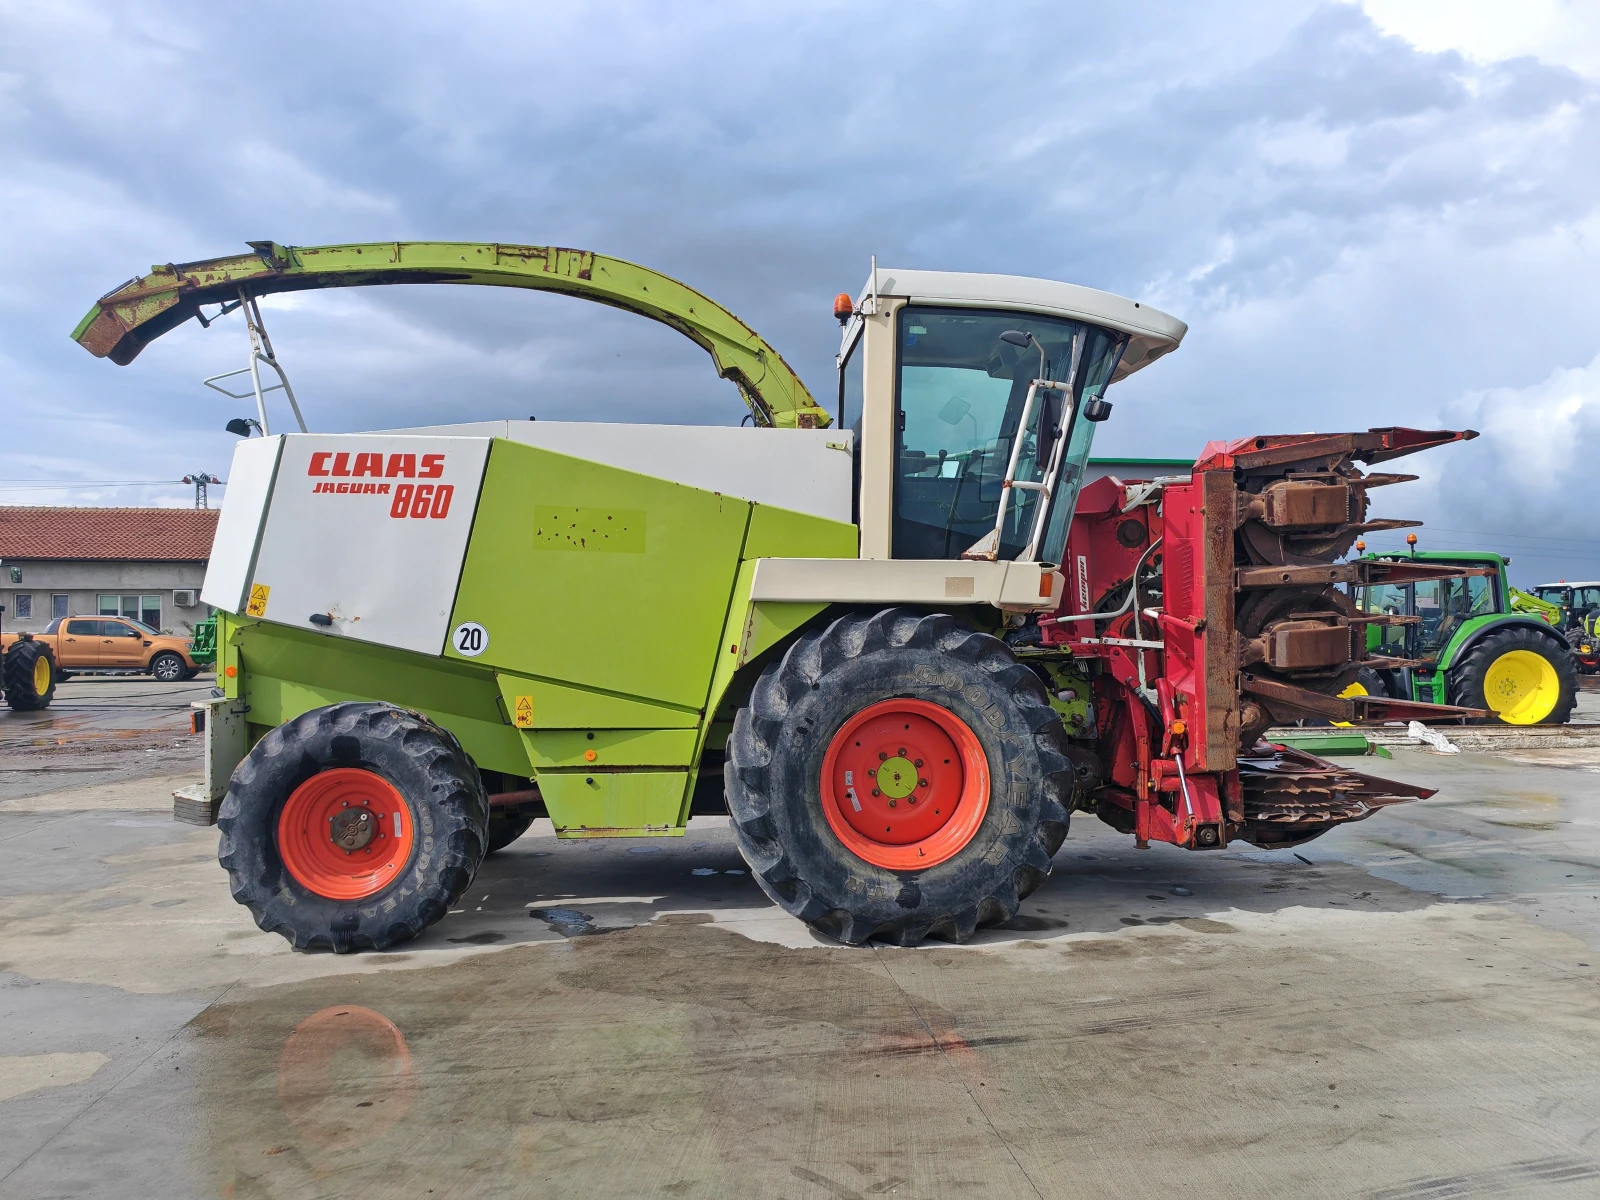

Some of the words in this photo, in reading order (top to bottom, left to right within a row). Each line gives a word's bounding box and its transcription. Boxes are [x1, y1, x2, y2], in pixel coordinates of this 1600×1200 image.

[308, 452, 445, 478] CLAAS
[312, 482, 391, 495] JAGUAR
[390, 484, 454, 519] 860
[459, 627, 482, 651] 20
[914, 664, 1028, 867] GOODYEAR
